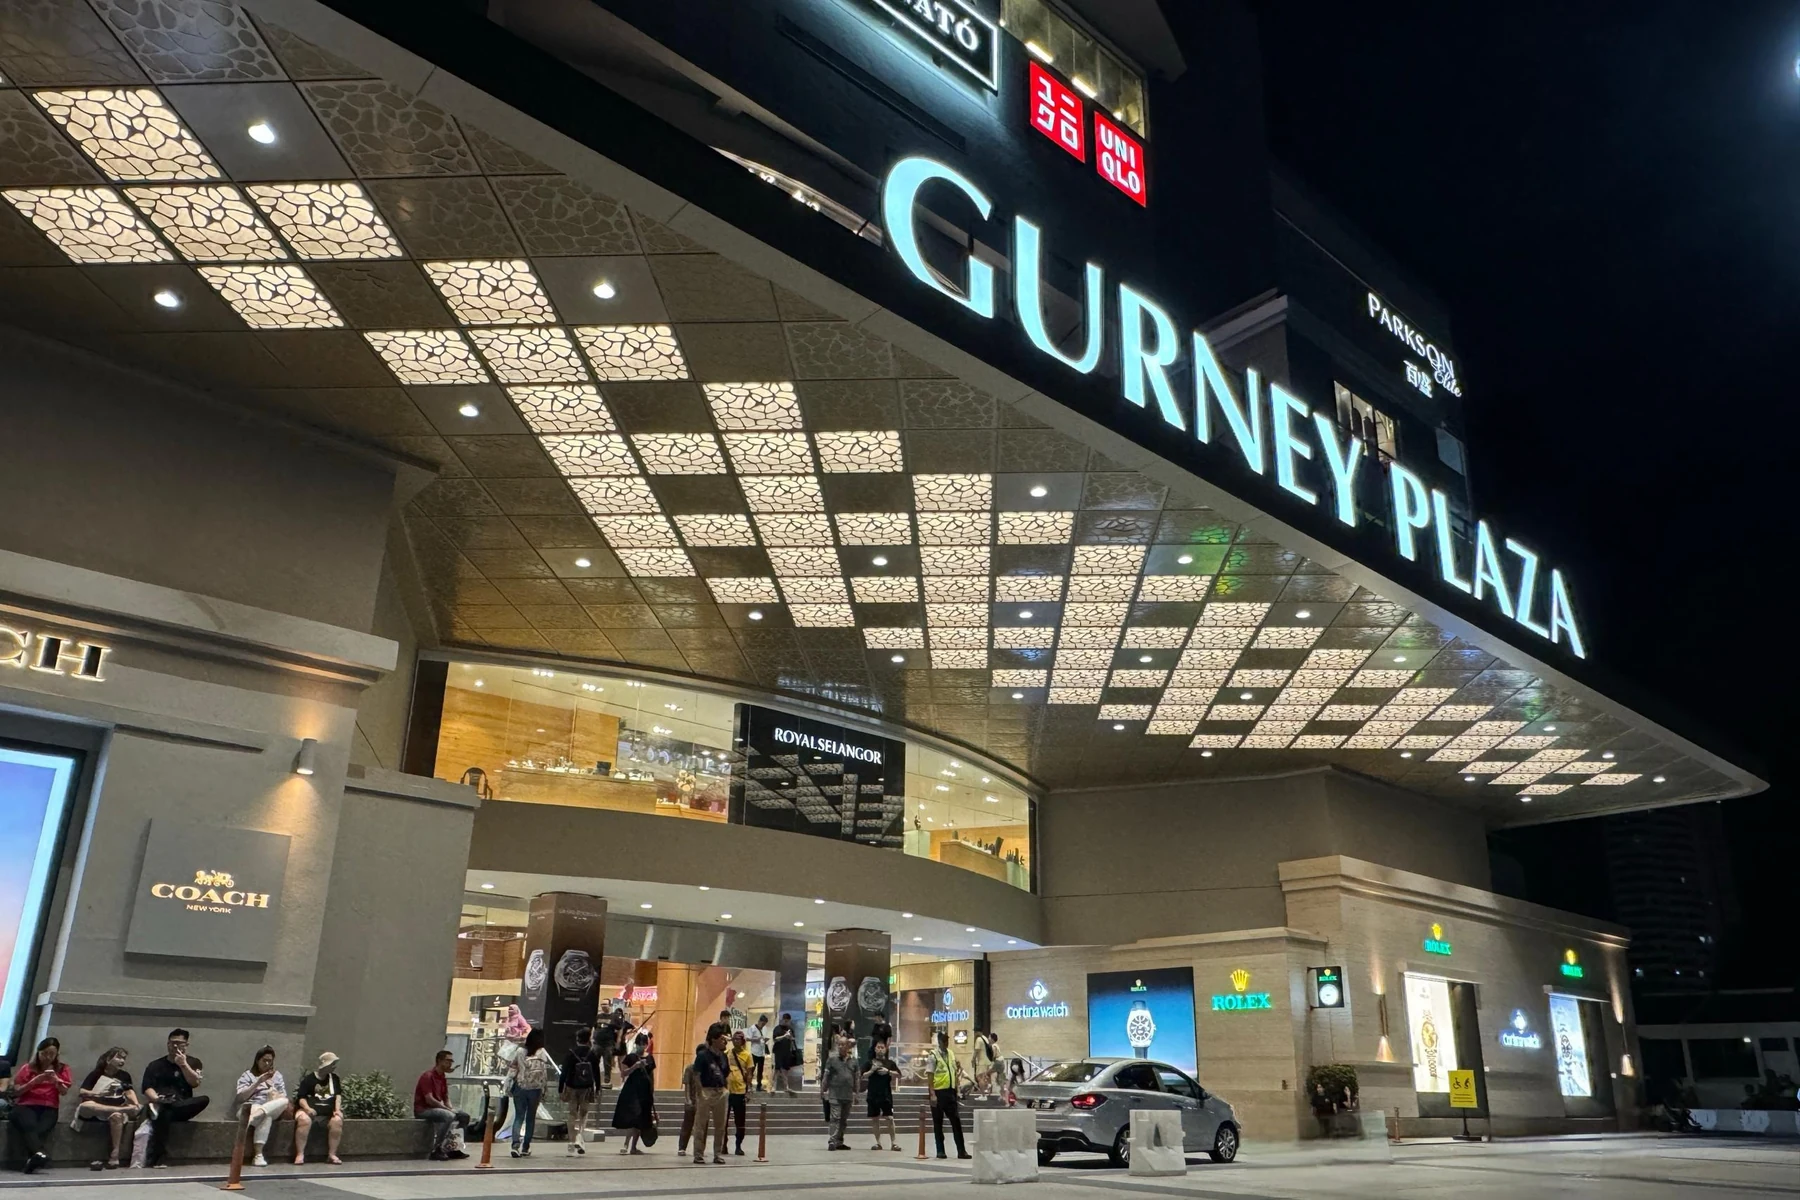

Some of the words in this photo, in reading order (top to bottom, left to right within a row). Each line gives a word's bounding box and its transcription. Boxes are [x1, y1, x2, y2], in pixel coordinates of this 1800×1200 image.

[905, 0, 979, 51] ATÓ
[1100, 123, 1136, 169] UNI
[1101, 151, 1142, 194] QLO
[1367, 291, 1455, 379] PARKSON
[882, 155, 1364, 528] GURNEY
[1389, 460, 1587, 660] PLAZA
[774, 727, 818, 750] ROYAL
[817, 738, 882, 765] SELANGOR
[151, 883, 271, 908] COACH
[186, 904, 207, 912] NEW
[209, 906, 232, 914] YORK
[1211, 992, 1272, 1010] ROLEX
